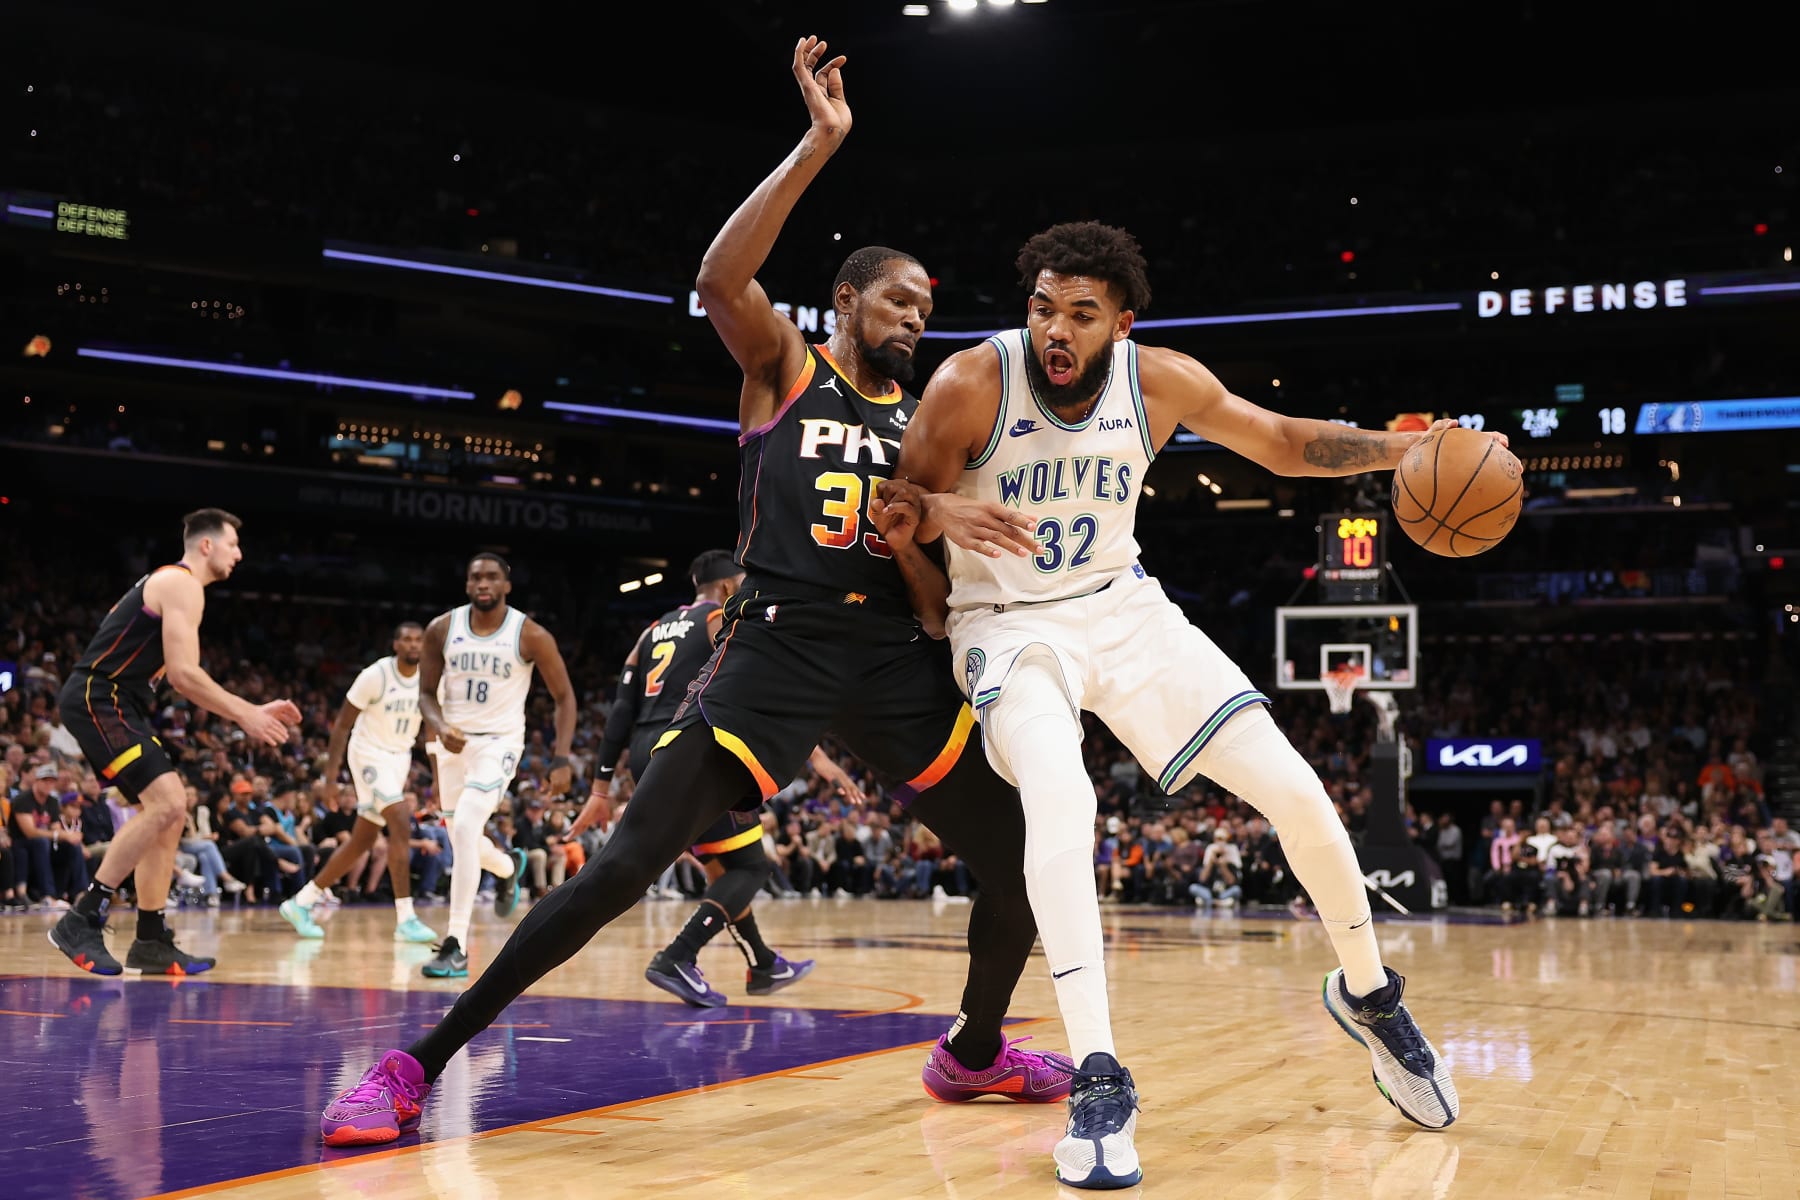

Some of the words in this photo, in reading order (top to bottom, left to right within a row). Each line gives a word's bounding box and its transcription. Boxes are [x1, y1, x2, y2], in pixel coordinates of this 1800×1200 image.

[1478, 279, 1687, 318] DEFENSE
[1600, 407, 1626, 435] 18
[799, 418, 901, 466] PH
[997, 456, 1132, 508] WOLVES
[391, 488, 568, 531] HORNITOS
[1032, 513, 1099, 574] 32
[1343, 536, 1372, 568] 10
[449, 652, 512, 680] WOLVES
[645, 641, 676, 697] 2
[466, 679, 489, 704] 18
[395, 718, 410, 735] 11
[1440, 744, 1528, 767] KIA
